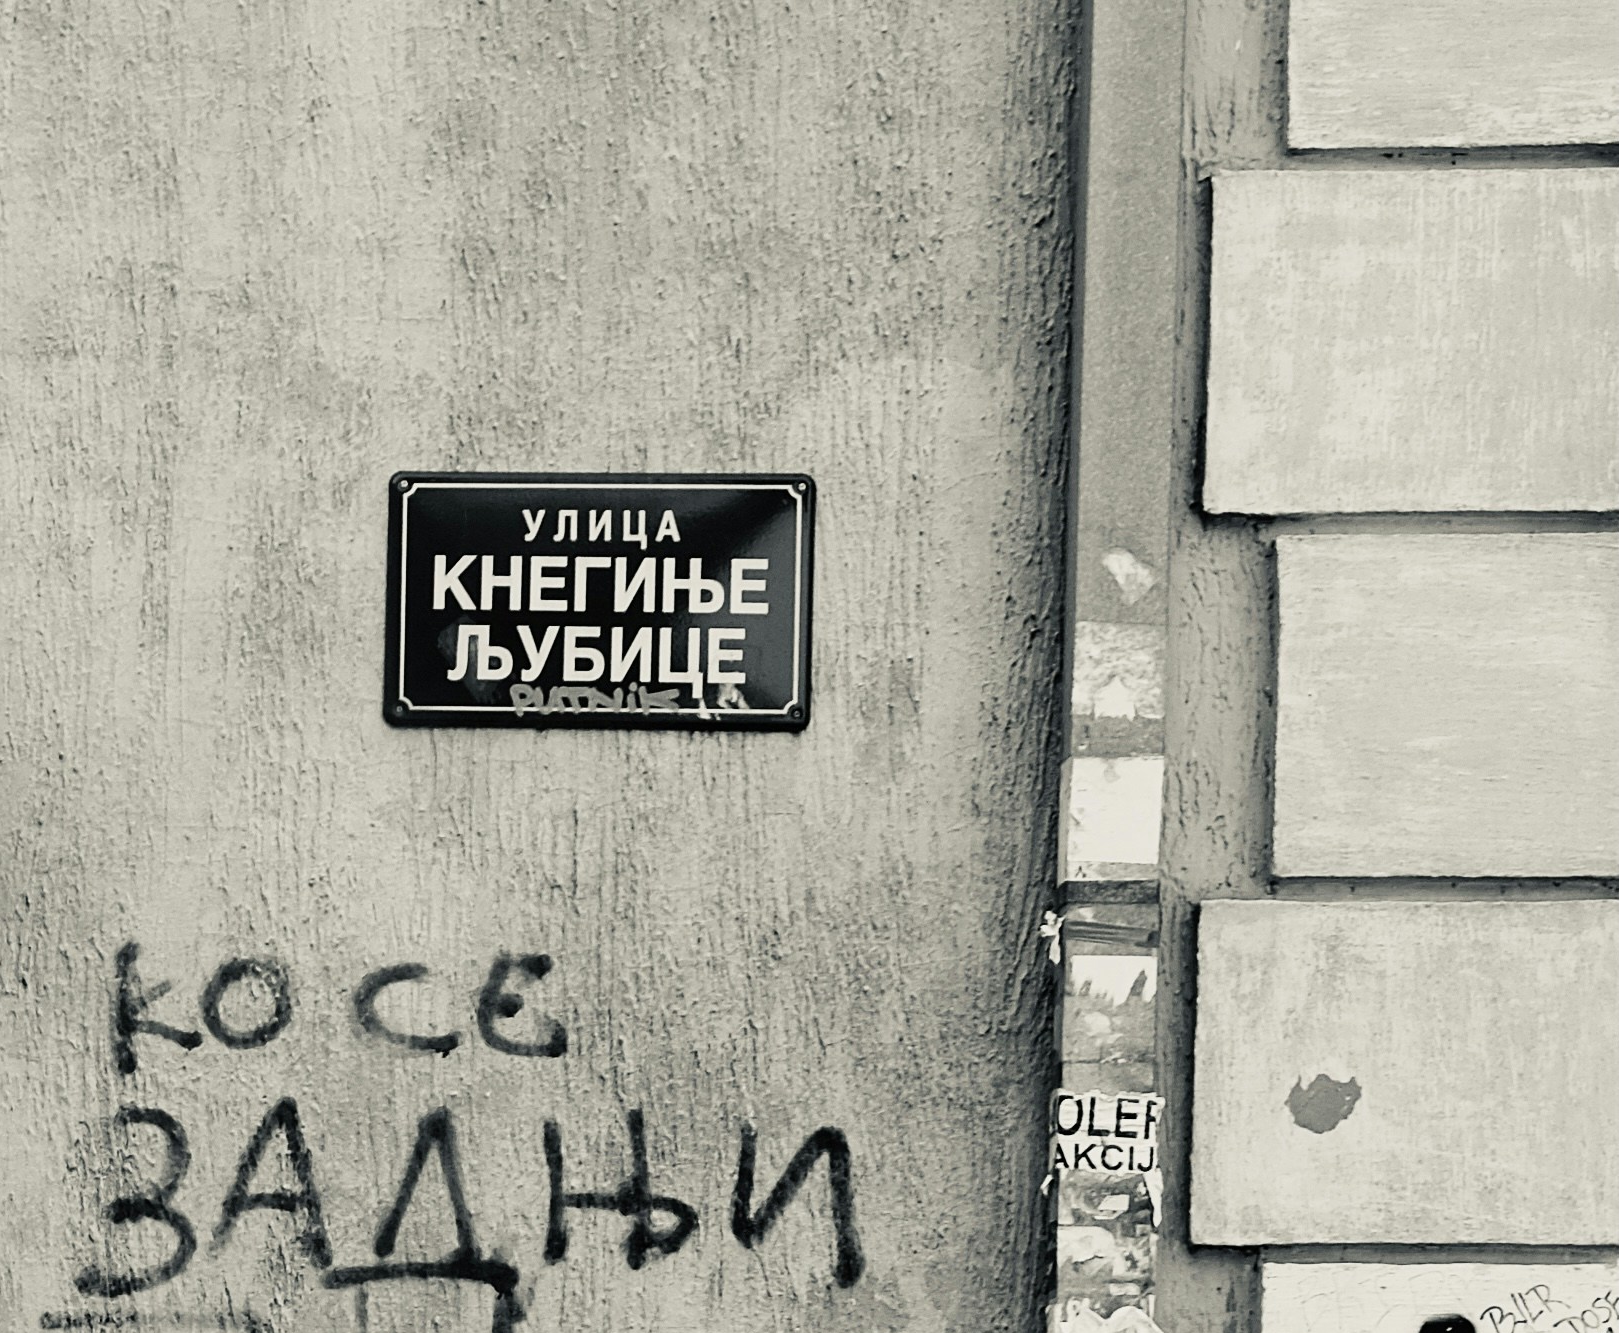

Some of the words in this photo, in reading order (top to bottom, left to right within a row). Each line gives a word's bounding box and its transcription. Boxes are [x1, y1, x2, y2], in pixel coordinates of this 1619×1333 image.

[522, 509, 681, 550] УЛИЦА
[432, 554, 769, 615] КНЕГИЊЕ
[447, 624, 746, 698] ЉУБИЦЕ
[1054, 1143, 1158, 1172] AKCIJ
